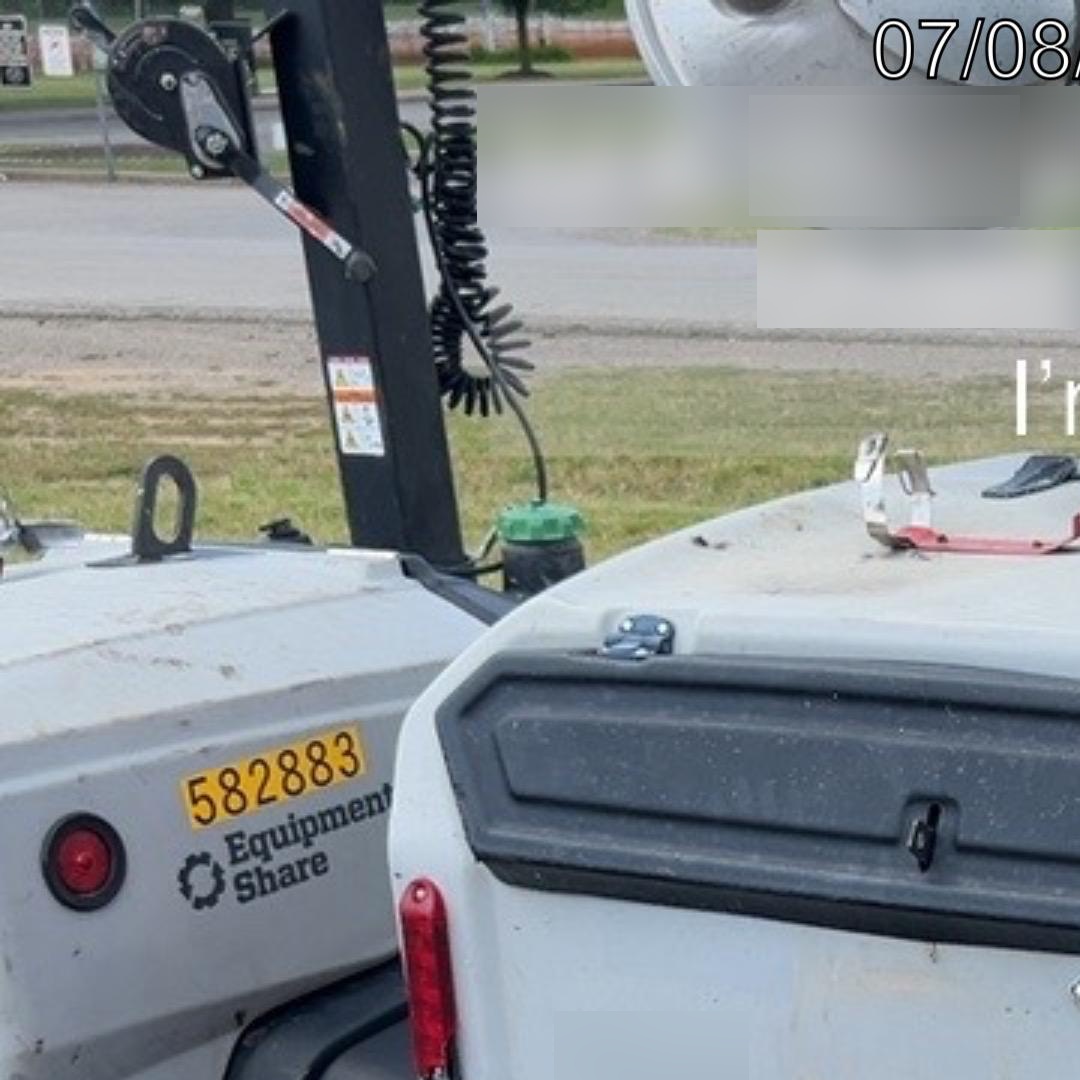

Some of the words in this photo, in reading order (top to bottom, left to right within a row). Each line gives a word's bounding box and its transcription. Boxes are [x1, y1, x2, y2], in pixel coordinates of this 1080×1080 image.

[187, 731, 361, 826] 582883
[224, 782, 393, 865] Equipment
[233, 851, 330, 904] Share
